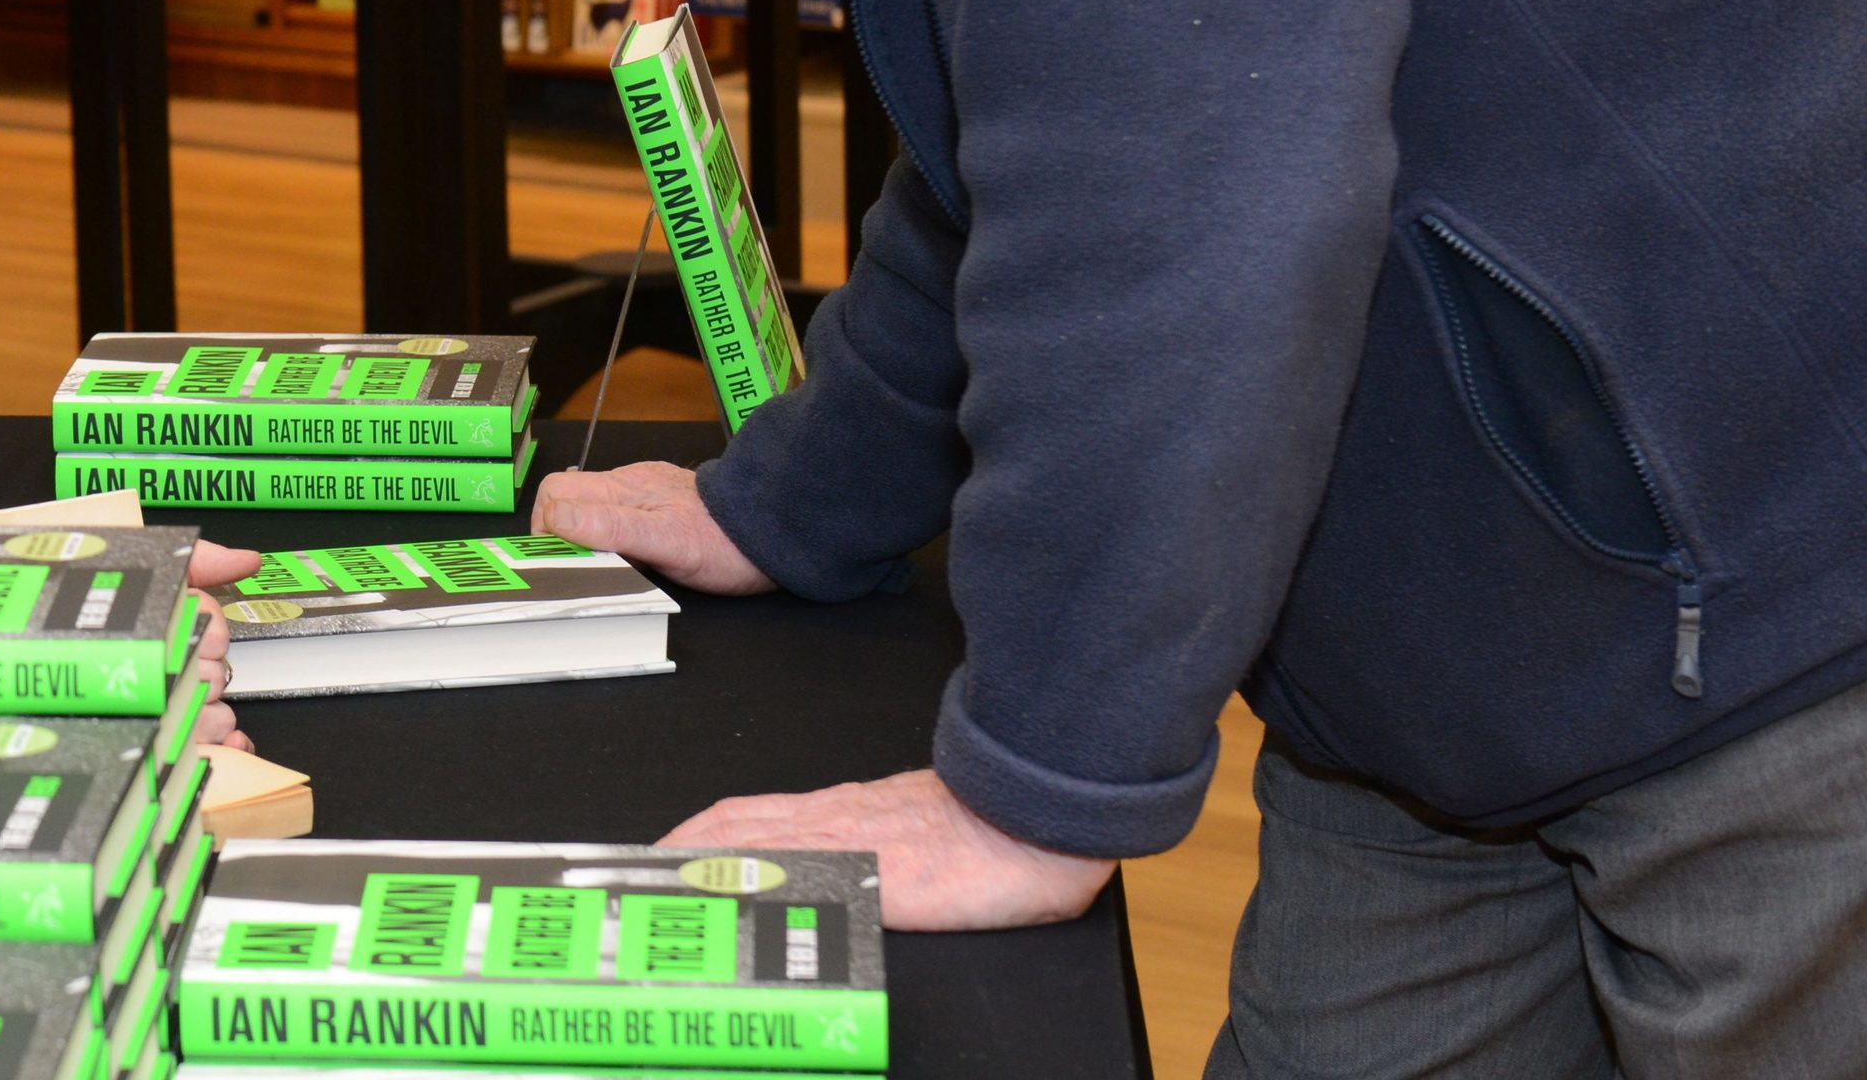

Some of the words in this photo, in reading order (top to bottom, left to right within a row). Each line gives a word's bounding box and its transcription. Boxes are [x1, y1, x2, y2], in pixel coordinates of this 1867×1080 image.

[625, 78, 671, 136] IAN
[646, 140, 714, 261] RANKIN
[692, 269, 736, 338] RATHER
[286, 356, 325, 365] BE
[365, 361, 412, 380] DEVIL
[717, 341, 746, 366] BE
[90, 372, 149, 394] IAN
[178, 350, 249, 394] RANKIN
[271, 366, 321, 395] RATHER
[358, 381, 401, 396] THE
[725, 366, 758, 402] THE
[72, 413, 123, 445] IAN
[137, 413, 253, 446] RANKIN
[269, 419, 334, 444] RATHER
[342, 420, 363, 444] BE
[369, 420, 402, 444] THE
[409, 420, 458, 445] DEVIL
[75, 467, 125, 497] IAN
[139, 468, 256, 501] RANKIN
[271, 475, 337, 500] RATHER
[345, 476, 365, 500] BE
[372, 476, 404, 501] THE
[411, 477, 461, 502] DEVIL
[325, 548, 390, 576] RATHER
[506, 536, 578, 557] IAN
[355, 576, 405, 588] BE
[411, 541, 511, 588] RANKIN
[16, 663, 86, 699] DEVIL
[371, 881, 458, 968] RANKIN
[238, 925, 317, 965] IAN
[211, 996, 289, 1044] IAN
[310, 998, 487, 1047] RANKIN
[511, 1007, 613, 1047] RATHER
[624, 1009, 656, 1047] BE
[667, 1010, 716, 1048] THE
[730, 1011, 803, 1050] DEVIL
